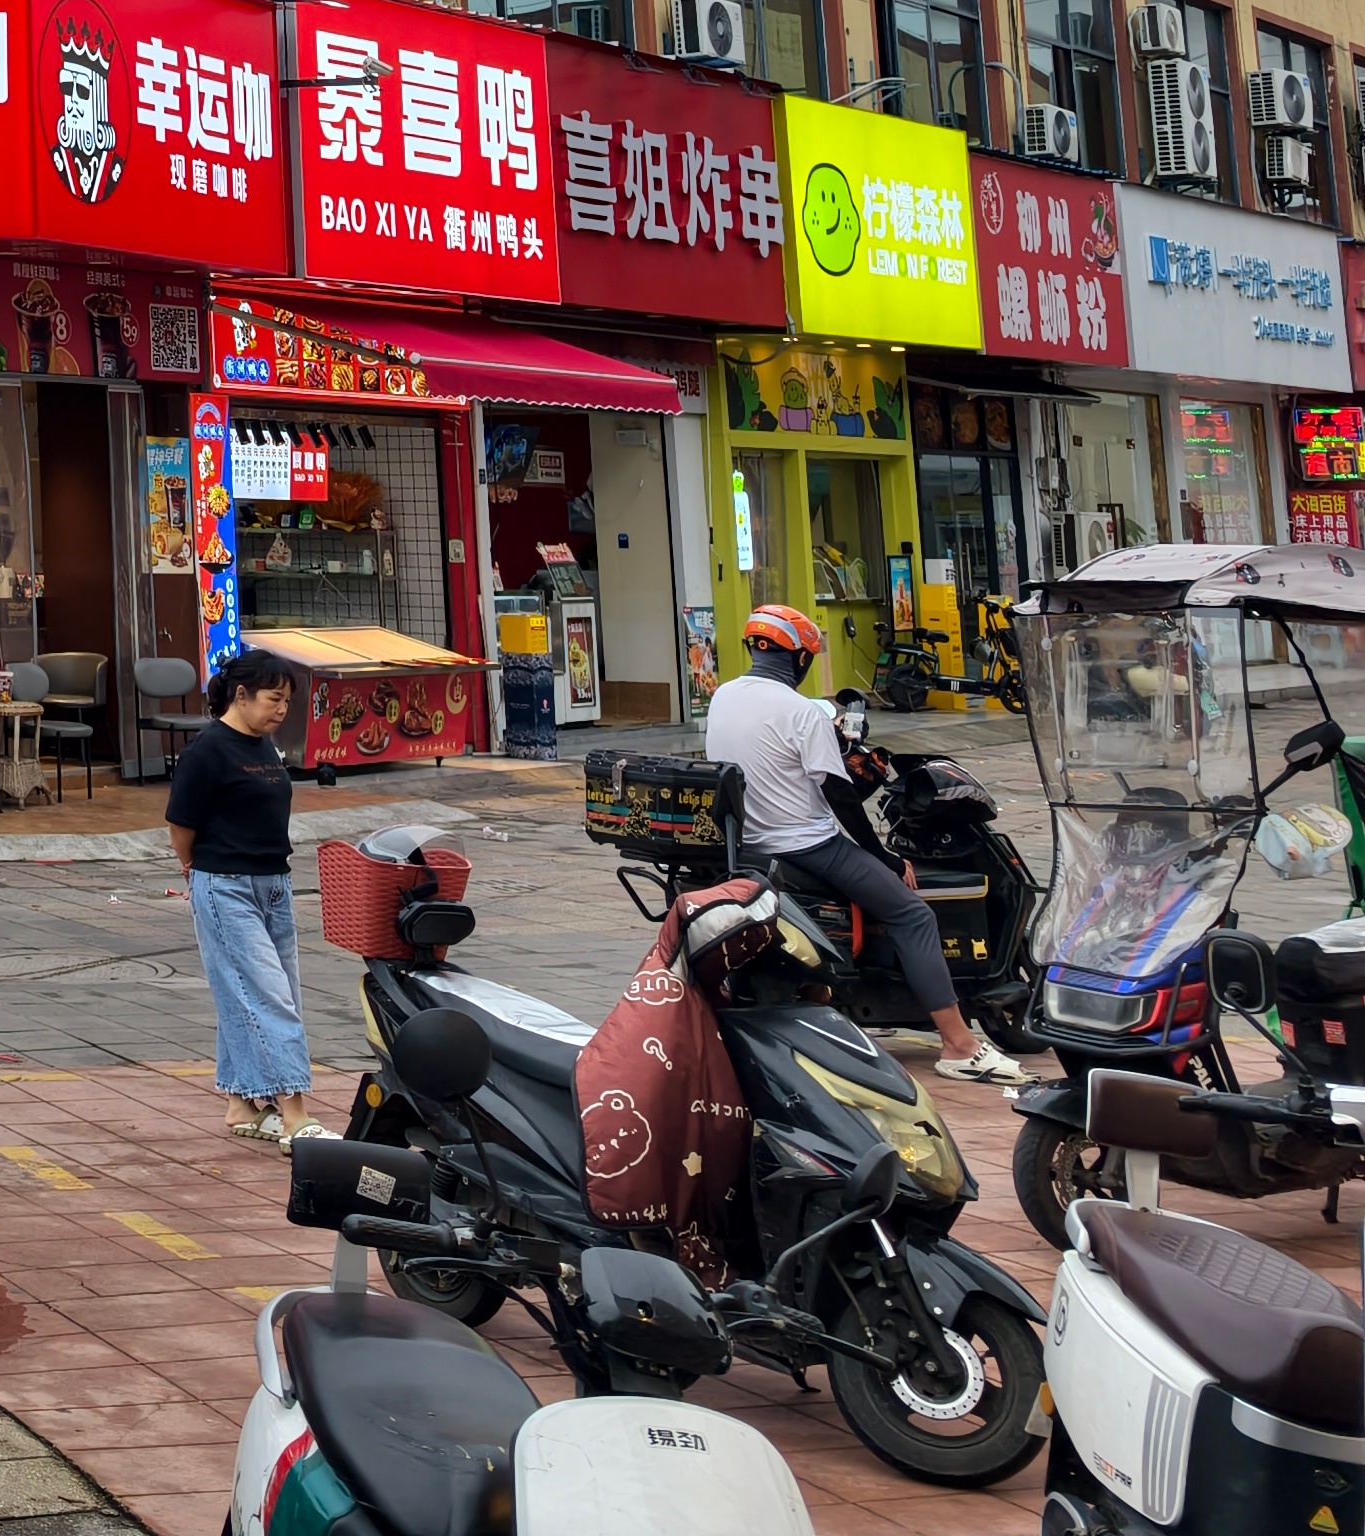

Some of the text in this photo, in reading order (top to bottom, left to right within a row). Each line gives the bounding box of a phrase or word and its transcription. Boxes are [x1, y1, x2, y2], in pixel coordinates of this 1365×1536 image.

[135, 37, 272, 161] 幸运咖
[316, 30, 538, 191] 暴喜鸭
[170, 153, 247, 204] 现磨咖啡
[561, 110, 785, 259] 喜姐炸串
[320, 195, 433, 242] BAO XI YA
[443, 204, 544, 261] 衢州鸭头
[861, 175, 964, 251] 柠檬森林
[1016, 189, 1072, 259] 柳州
[867, 247, 968, 286] LEMON FOREST
[56, 314, 67, 340] 8
[997, 263, 1108, 351] 螺蛳粉
[1296, 514, 1349, 529] 床上用品
